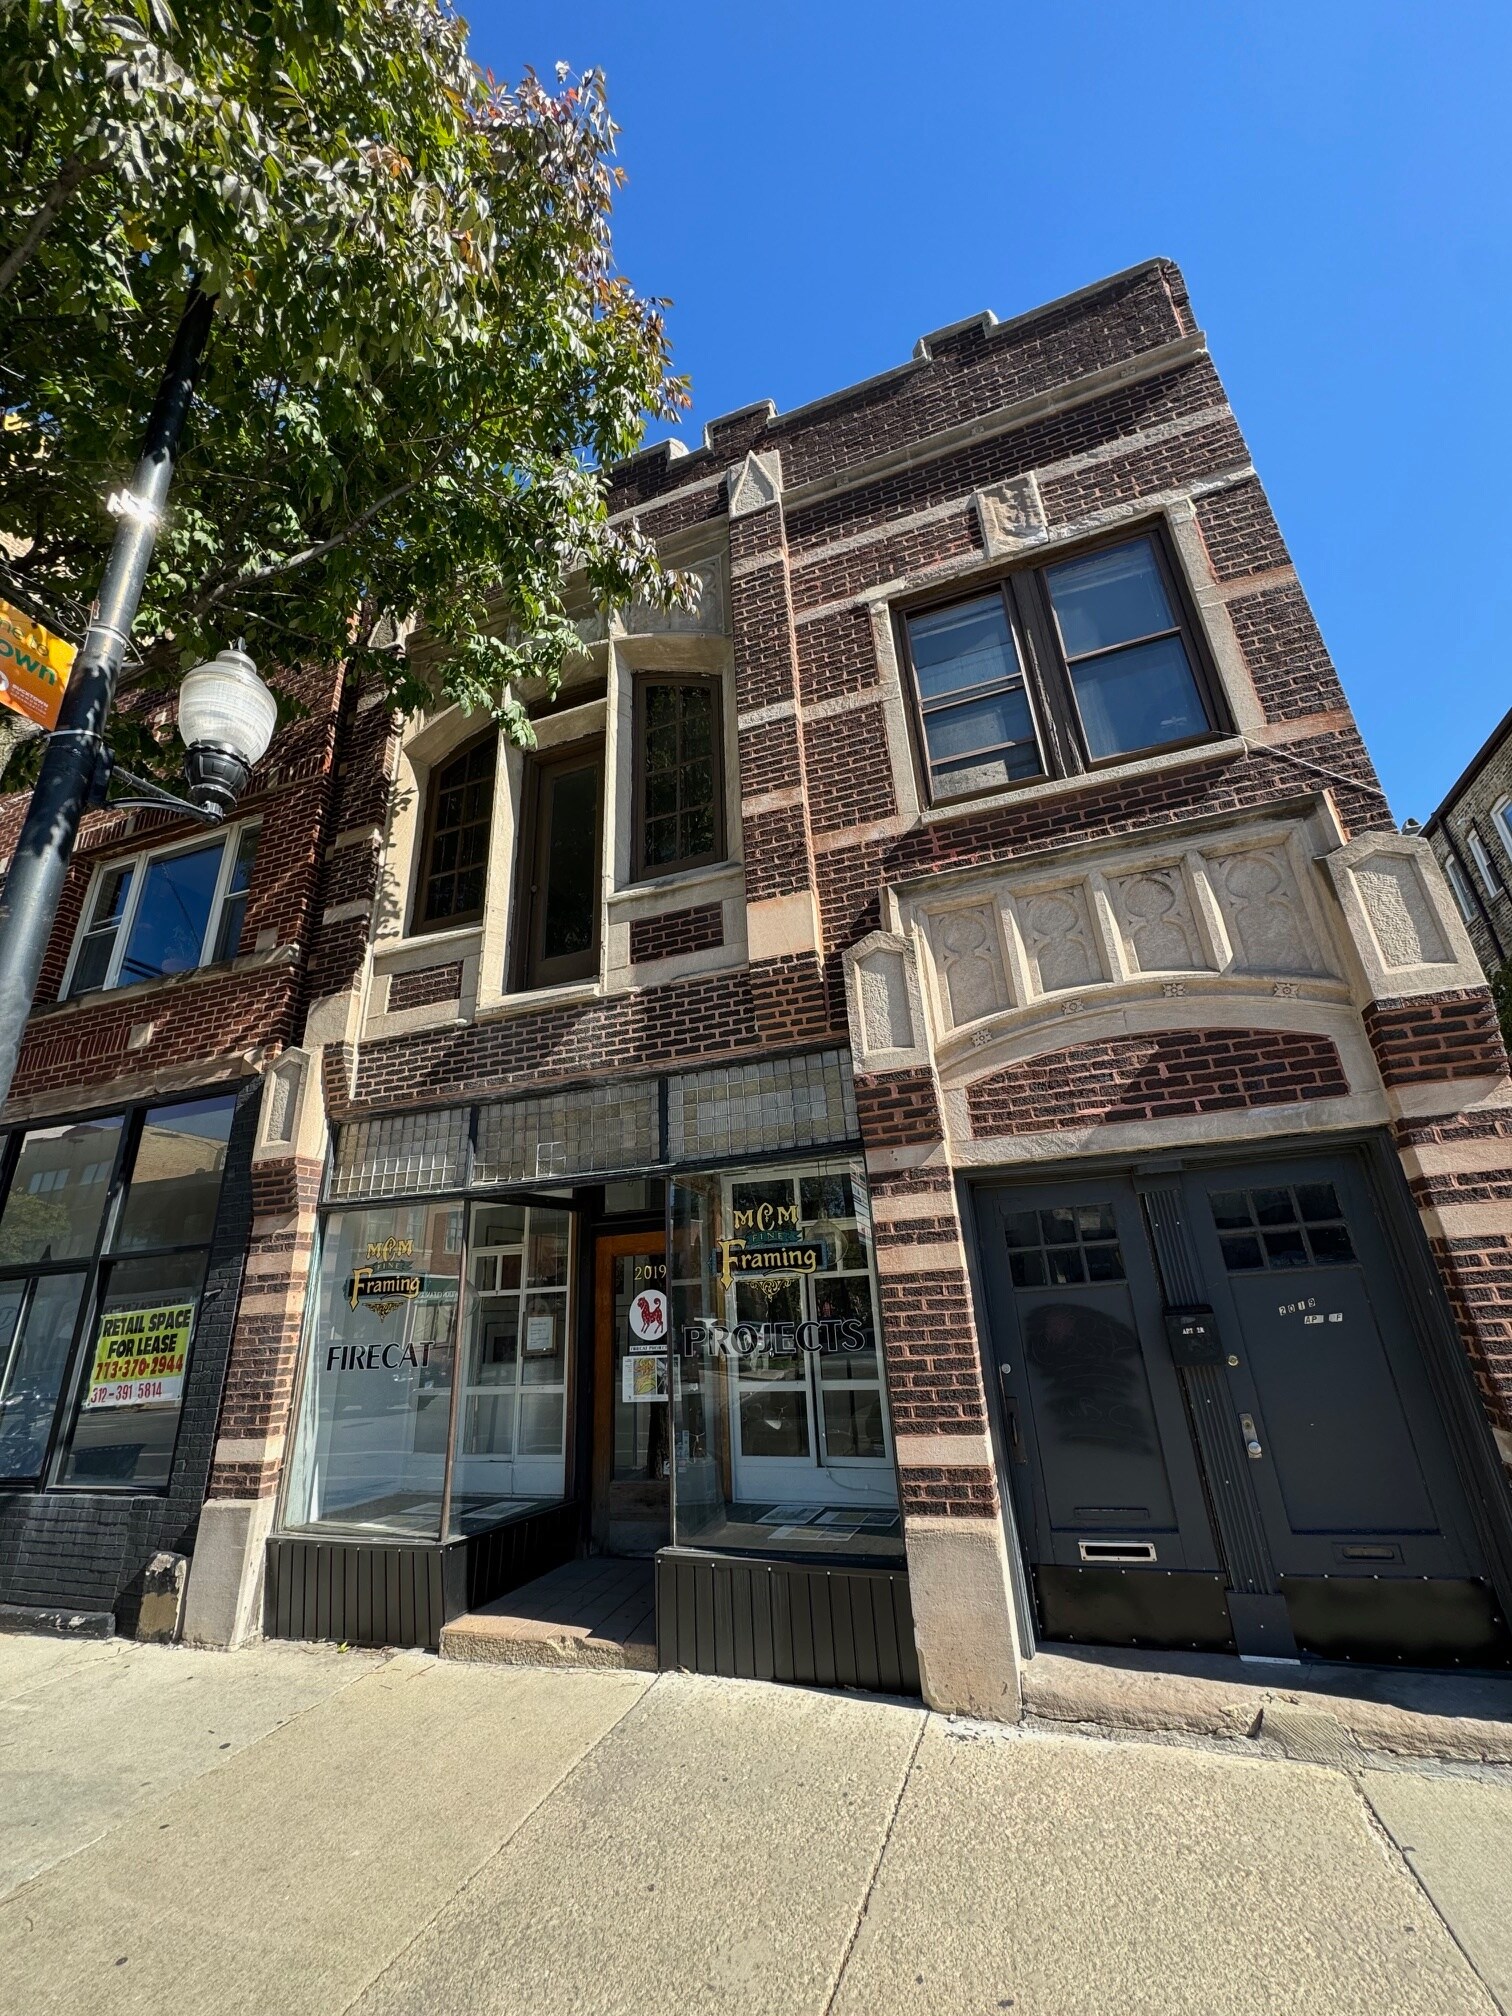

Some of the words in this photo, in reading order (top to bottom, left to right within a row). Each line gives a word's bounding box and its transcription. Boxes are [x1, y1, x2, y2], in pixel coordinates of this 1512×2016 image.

[752, 1231, 784, 1242] FINE
[376, 1261, 401, 1270] FINE
[634, 1264, 667, 1280] 2019
[718, 1238, 817, 1291] Framing
[349, 1267, 421, 1312] Framing
[1279, 1298, 1316, 1316] 2019
[102, 1314, 145, 1337] RETAIL
[148, 1309, 192, 1330] SPACE
[107, 1339, 135, 1359] FOR
[136, 1333, 178, 1356] LEASE
[682, 1318, 866, 1358] PROJECTS
[326, 1341, 435, 1371] FIRECAT
[137, 1382, 163, 1399] 5814
